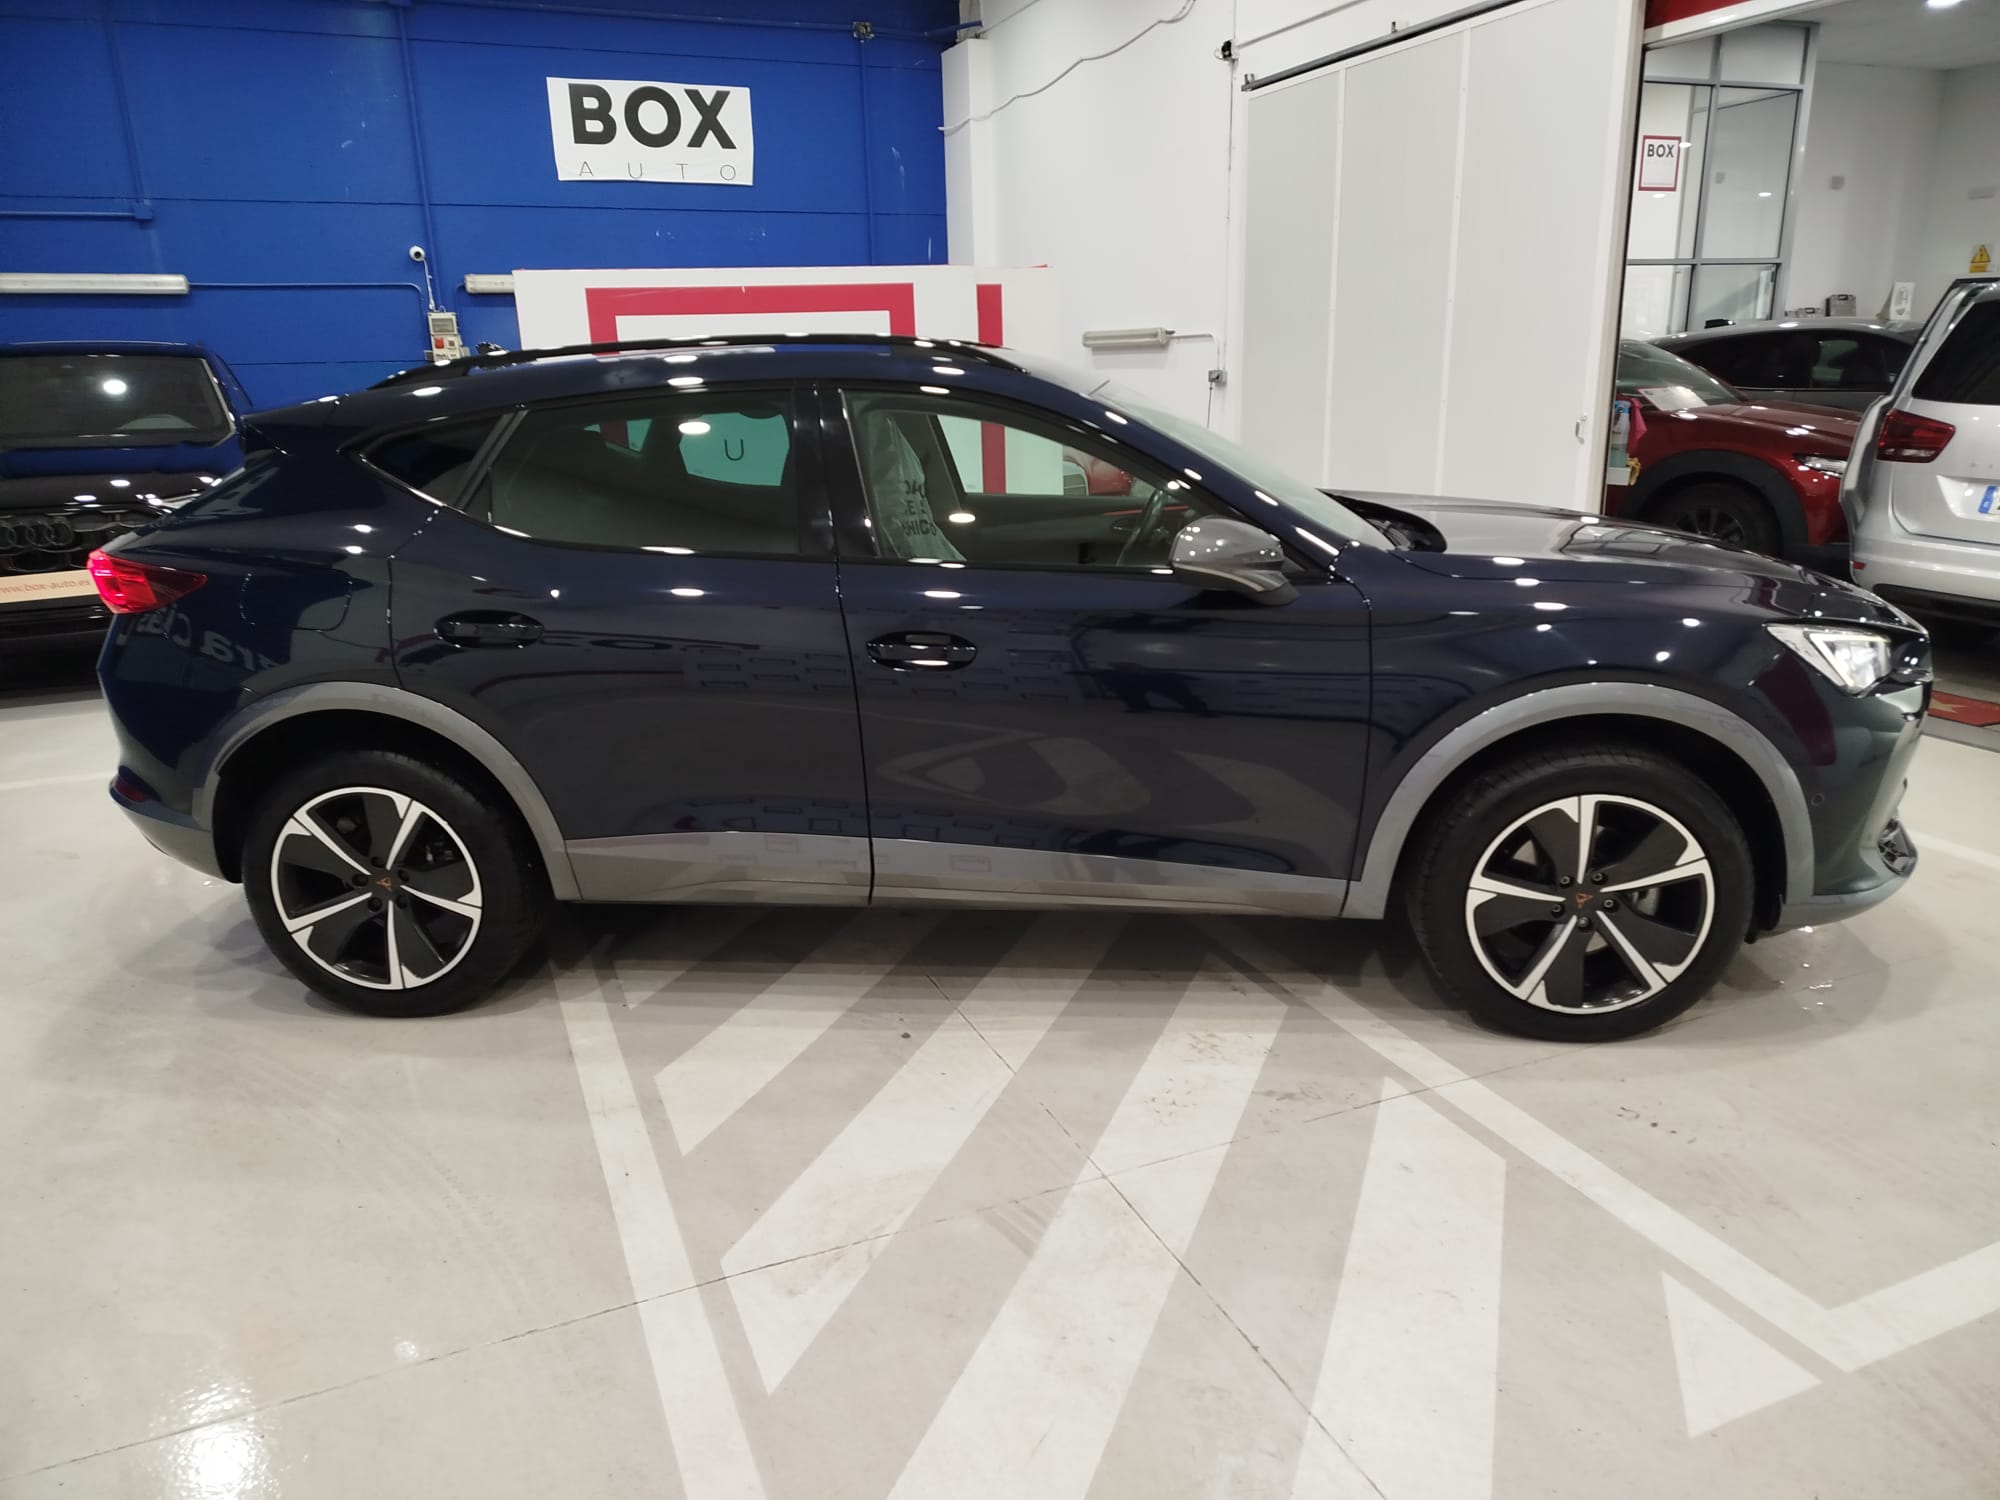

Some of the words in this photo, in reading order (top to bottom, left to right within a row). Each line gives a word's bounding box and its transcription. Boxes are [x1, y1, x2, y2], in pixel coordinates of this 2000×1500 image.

[568, 83, 737, 149] BOX
[1647, 144, 1675, 158] BOX
[579, 160, 737, 181] AUTO
